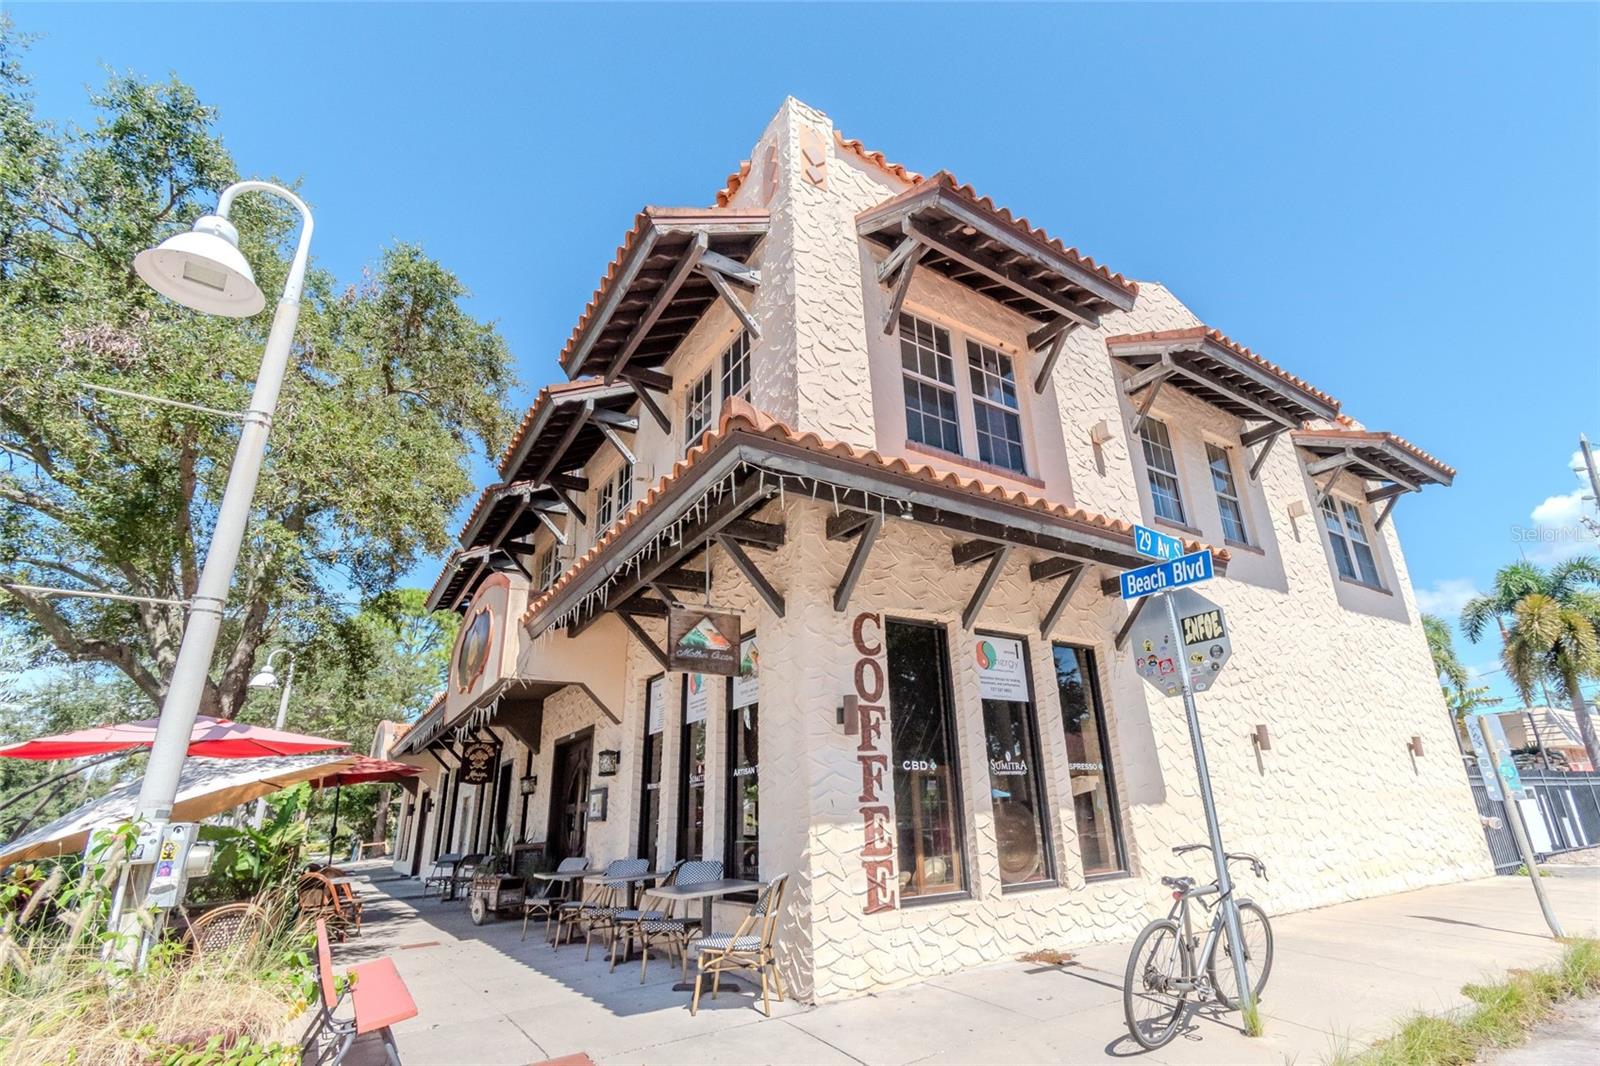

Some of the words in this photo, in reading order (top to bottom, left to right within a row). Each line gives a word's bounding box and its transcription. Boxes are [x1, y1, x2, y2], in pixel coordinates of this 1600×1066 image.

[1138, 529, 1152, 552] 29
[1157, 535, 1170, 558] Av
[1173, 542, 1181, 558] S
[1127, 567, 1166, 595] Beach
[1172, 556, 1204, 583] Blvd
[853, 612, 895, 915] COFFEE
[902, 760, 927, 771] CBD
[990, 758, 1028, 771] SUMITRA
[1068, 762, 1098, 770] SPRESSO
